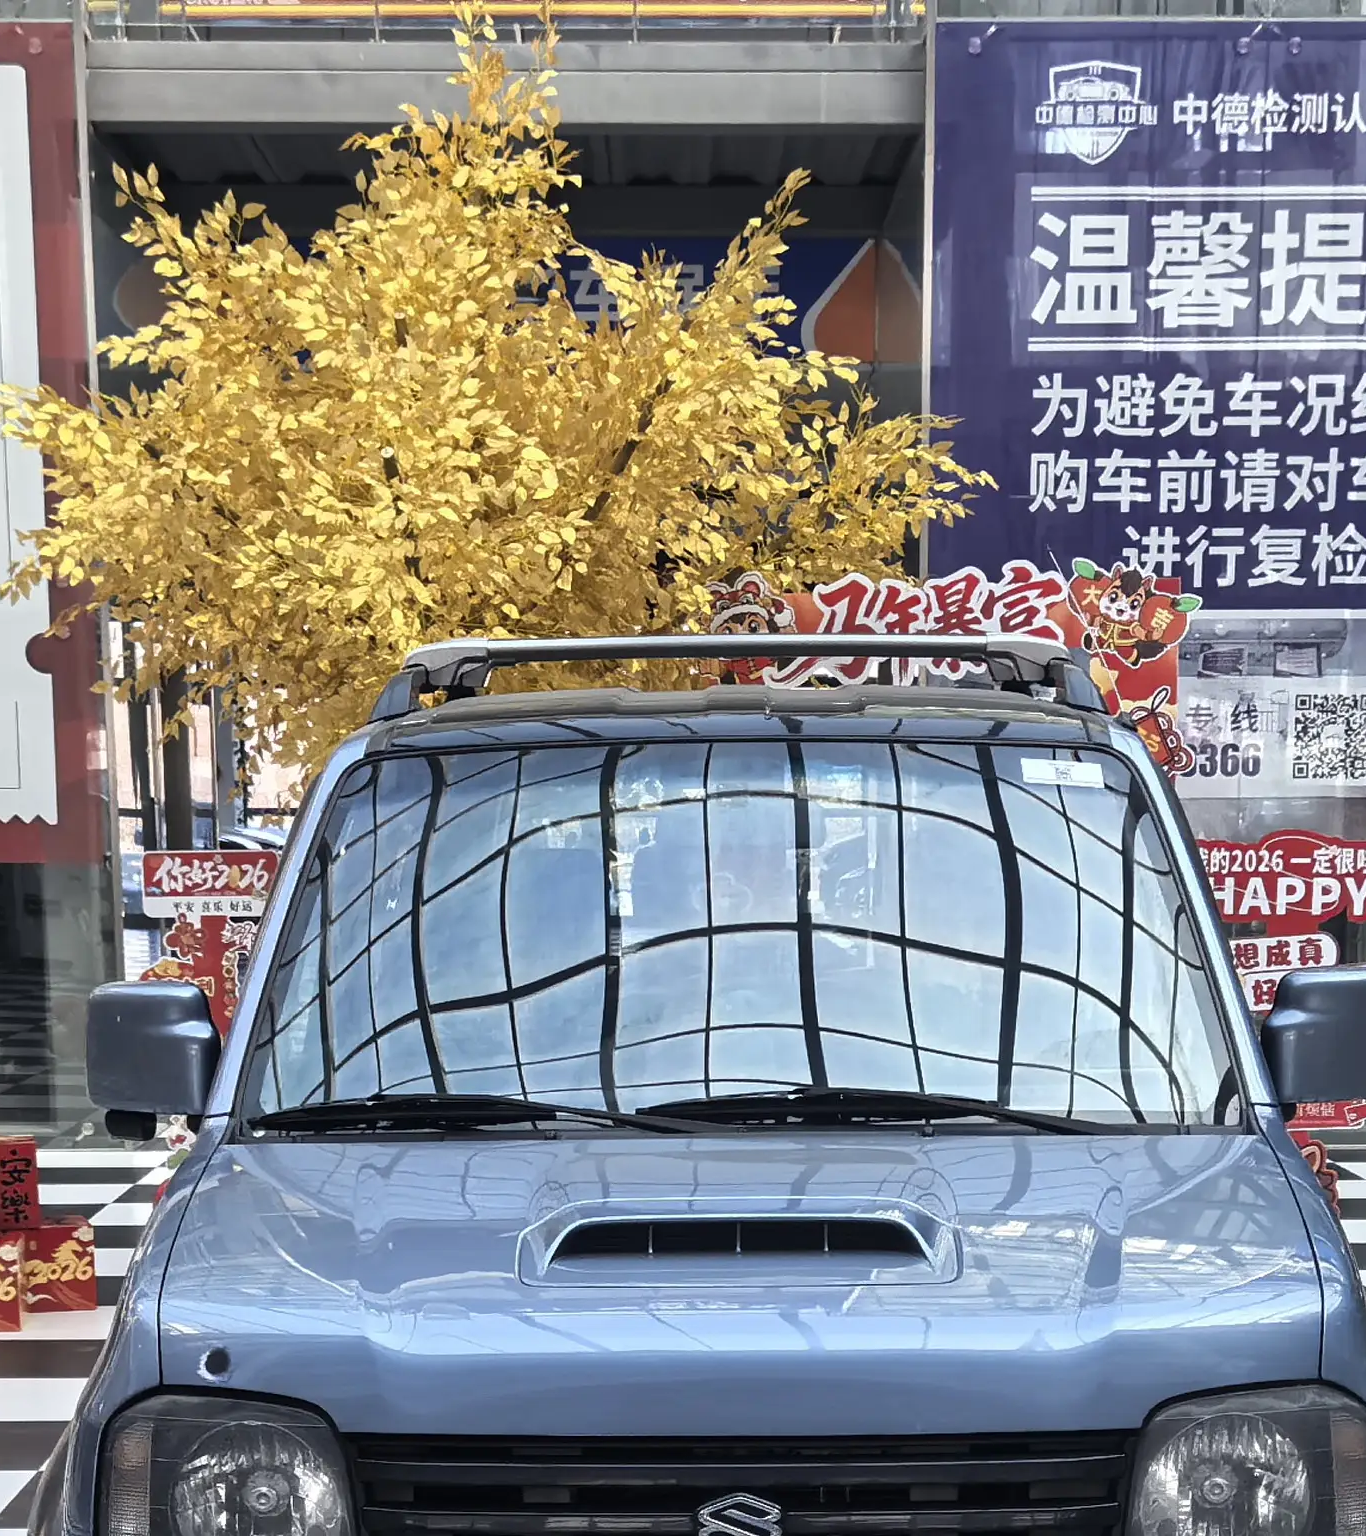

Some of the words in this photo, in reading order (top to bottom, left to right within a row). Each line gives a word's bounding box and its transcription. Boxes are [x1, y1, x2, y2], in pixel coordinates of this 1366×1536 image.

[1082, 586, 1101, 606] 大
[1152, 606, 1175, 632] 吉
[25, 1256, 94, 1289] 2026
